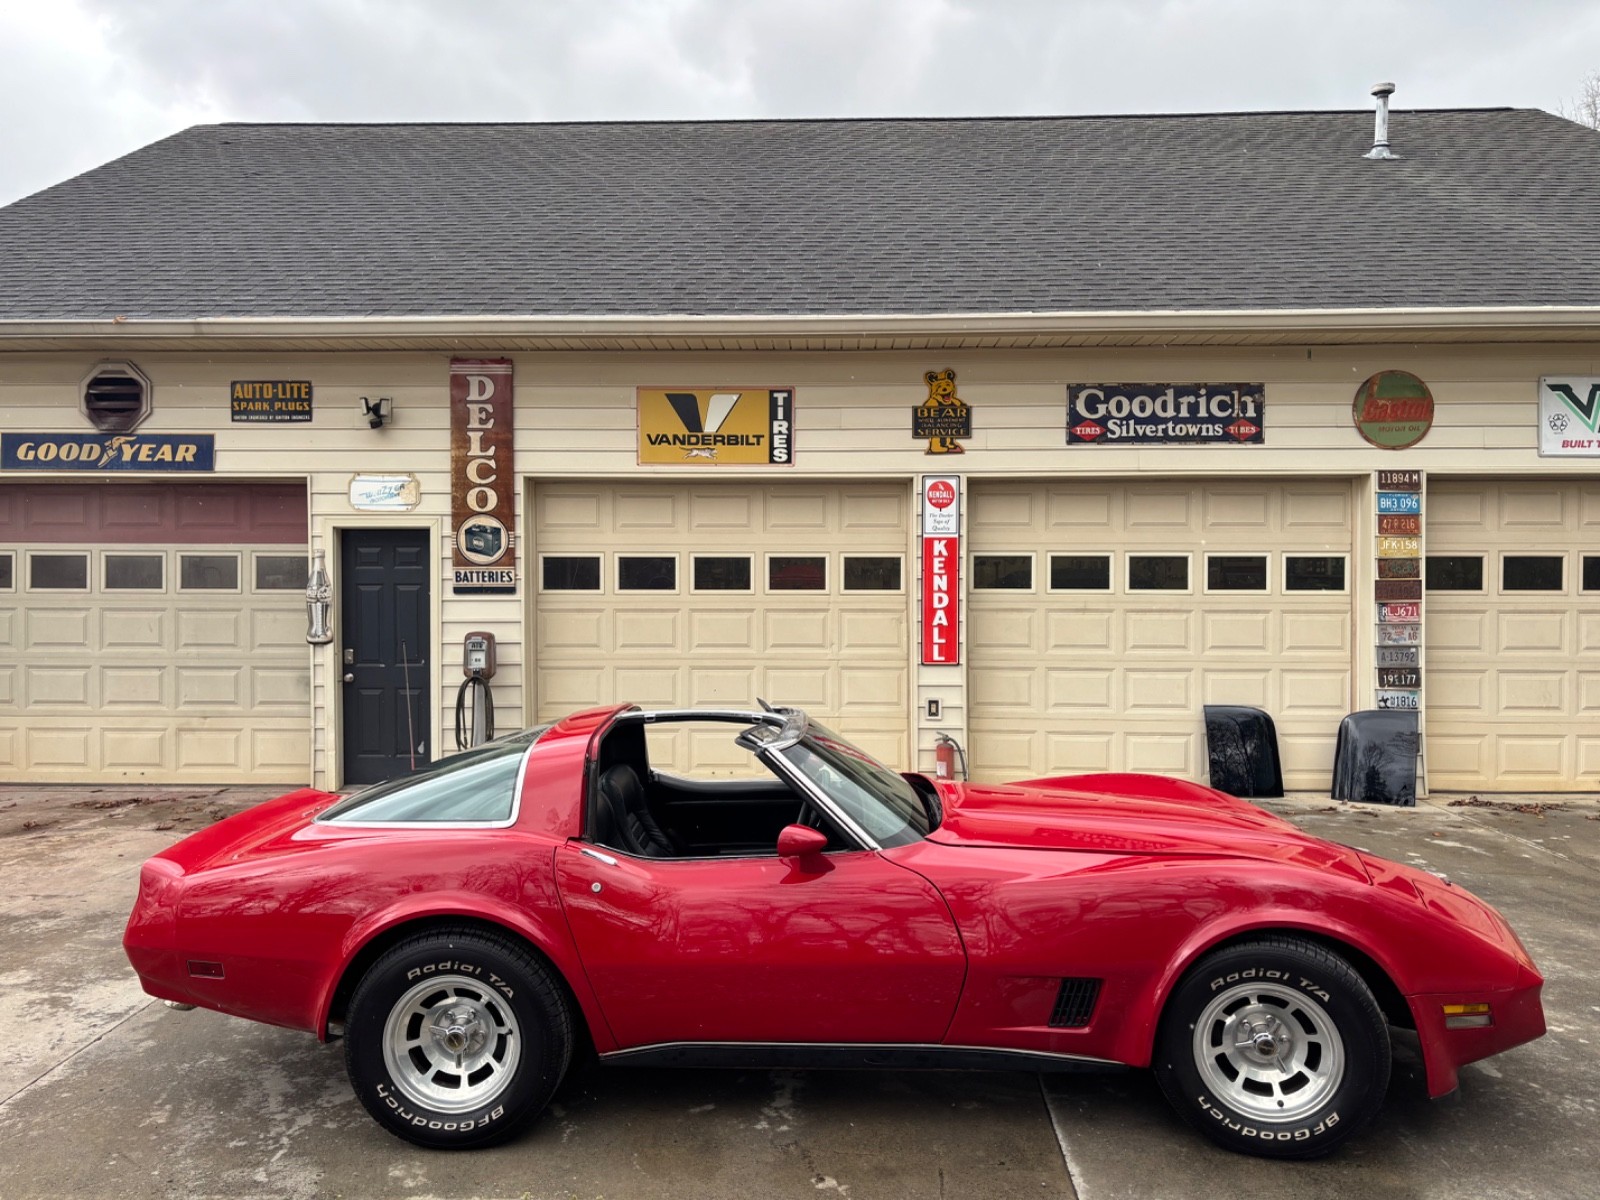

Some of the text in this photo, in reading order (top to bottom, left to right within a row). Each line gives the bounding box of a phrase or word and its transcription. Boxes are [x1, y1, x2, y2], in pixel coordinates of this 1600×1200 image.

[233, 383, 309, 399] AUTO-LITE
[233, 401, 310, 411] SPARK PLUGS
[1075, 388, 1257, 419] Goodrich
[917, 408, 967, 417] BEAR
[772, 392, 789, 462] TIRES
[917, 428, 966, 436] SERVICE
[1075, 426, 1101, 435] TIRES
[1106, 419, 1224, 439] Silvertowns
[465, 375, 498, 513] DELCO
[646, 433, 765, 446] VANDERBILT
[1561, 440, 1594, 448] BUILT
[929, 491, 953, 499] KENDALL
[1380, 498, 1418, 509] BH3 096
[455, 570, 513, 583] BATTERIES
[931, 539, 949, 661] KENDALL
[406, 960, 515, 999] Radial T/A
[1210, 967, 1331, 1003] Radial T/A
[376, 1083, 505, 1132] BFGoodrich
[1197, 1095, 1340, 1141] BFGoodrich
